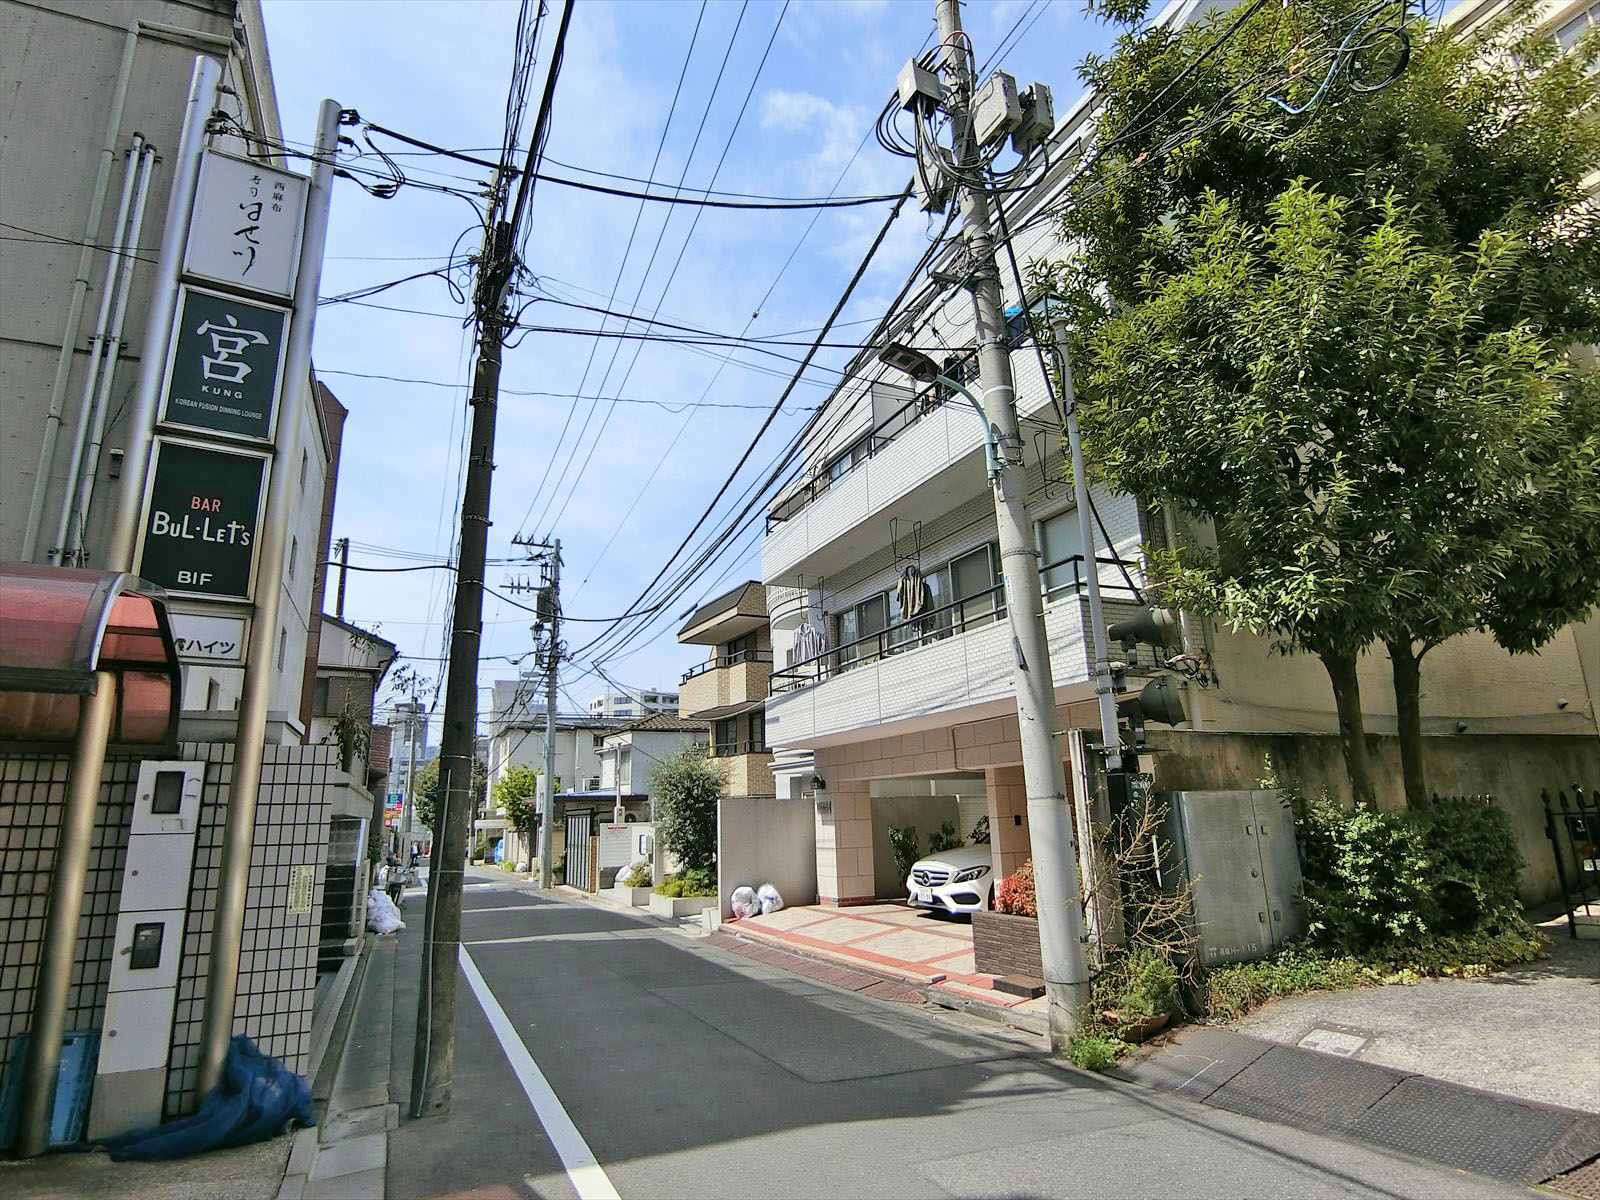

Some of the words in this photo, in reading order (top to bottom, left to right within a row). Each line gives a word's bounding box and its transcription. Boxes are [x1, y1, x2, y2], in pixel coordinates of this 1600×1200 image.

[196, 314, 270, 384] 宮
[201, 385, 243, 399] KUNG
[175, 398, 198, 408] KOREAN
[199, 401, 218, 412] FUSION
[241, 409, 263, 420] LOUNGE
[191, 496, 222, 513] BAR
